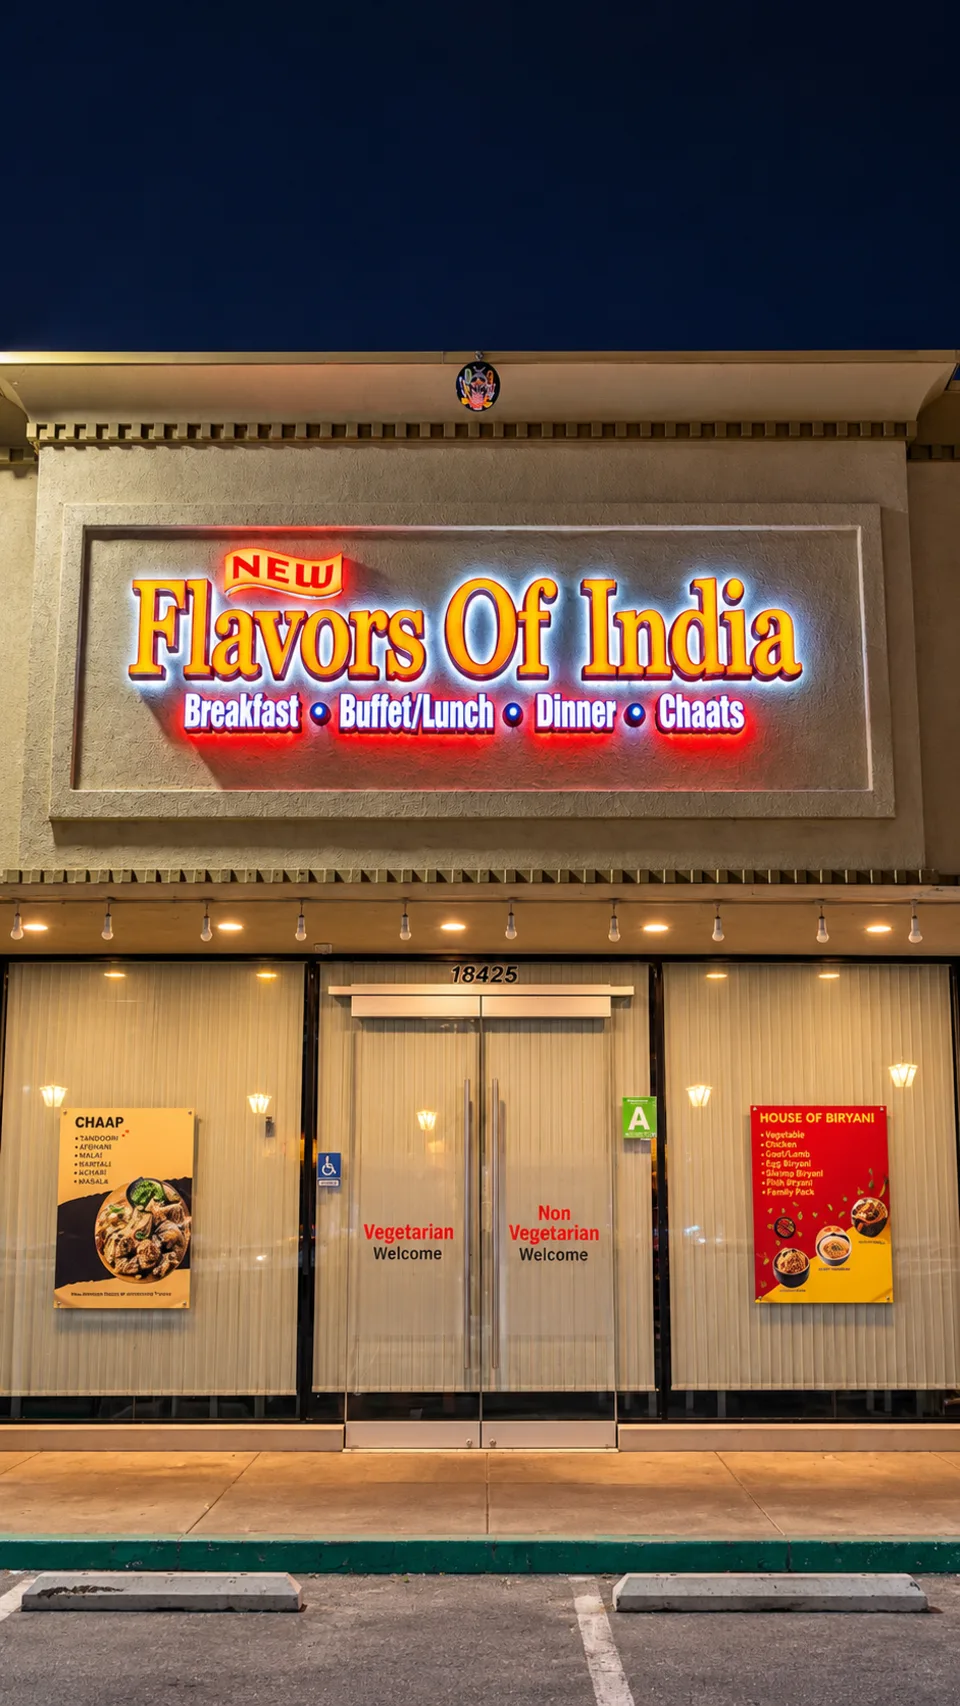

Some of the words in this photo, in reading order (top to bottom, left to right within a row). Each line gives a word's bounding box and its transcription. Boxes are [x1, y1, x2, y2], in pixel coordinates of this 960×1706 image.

[233, 555, 335, 589] NEW
[128, 577, 428, 682] Flavors
[444, 577, 559, 682] Of
[580, 577, 803, 682] India
[184, 692, 302, 733] Breakfast
[339, 693, 495, 734] Buffet/Lunch
[534, 693, 617, 734] Dinner
[656, 693, 745, 734] Chaats
[451, 964, 519, 984] 18425
[75, 1116, 124, 1128] CHAAP
[628, 1106, 650, 1130] A
[760, 1112, 803, 1123] HOUSE
[805, 1112, 822, 1123] OF
[825, 1112, 875, 1123] BIRYANI
[765, 1130, 805, 1140] Vegetable
[795, 1187, 815, 1196] Pack
[538, 1205, 571, 1221] Non
[363, 1223, 454, 1244] Vegetarian
[509, 1224, 600, 1245] Vegetarian
[373, 1246, 442, 1261] Welcome
[519, 1248, 589, 1262] Welcome
